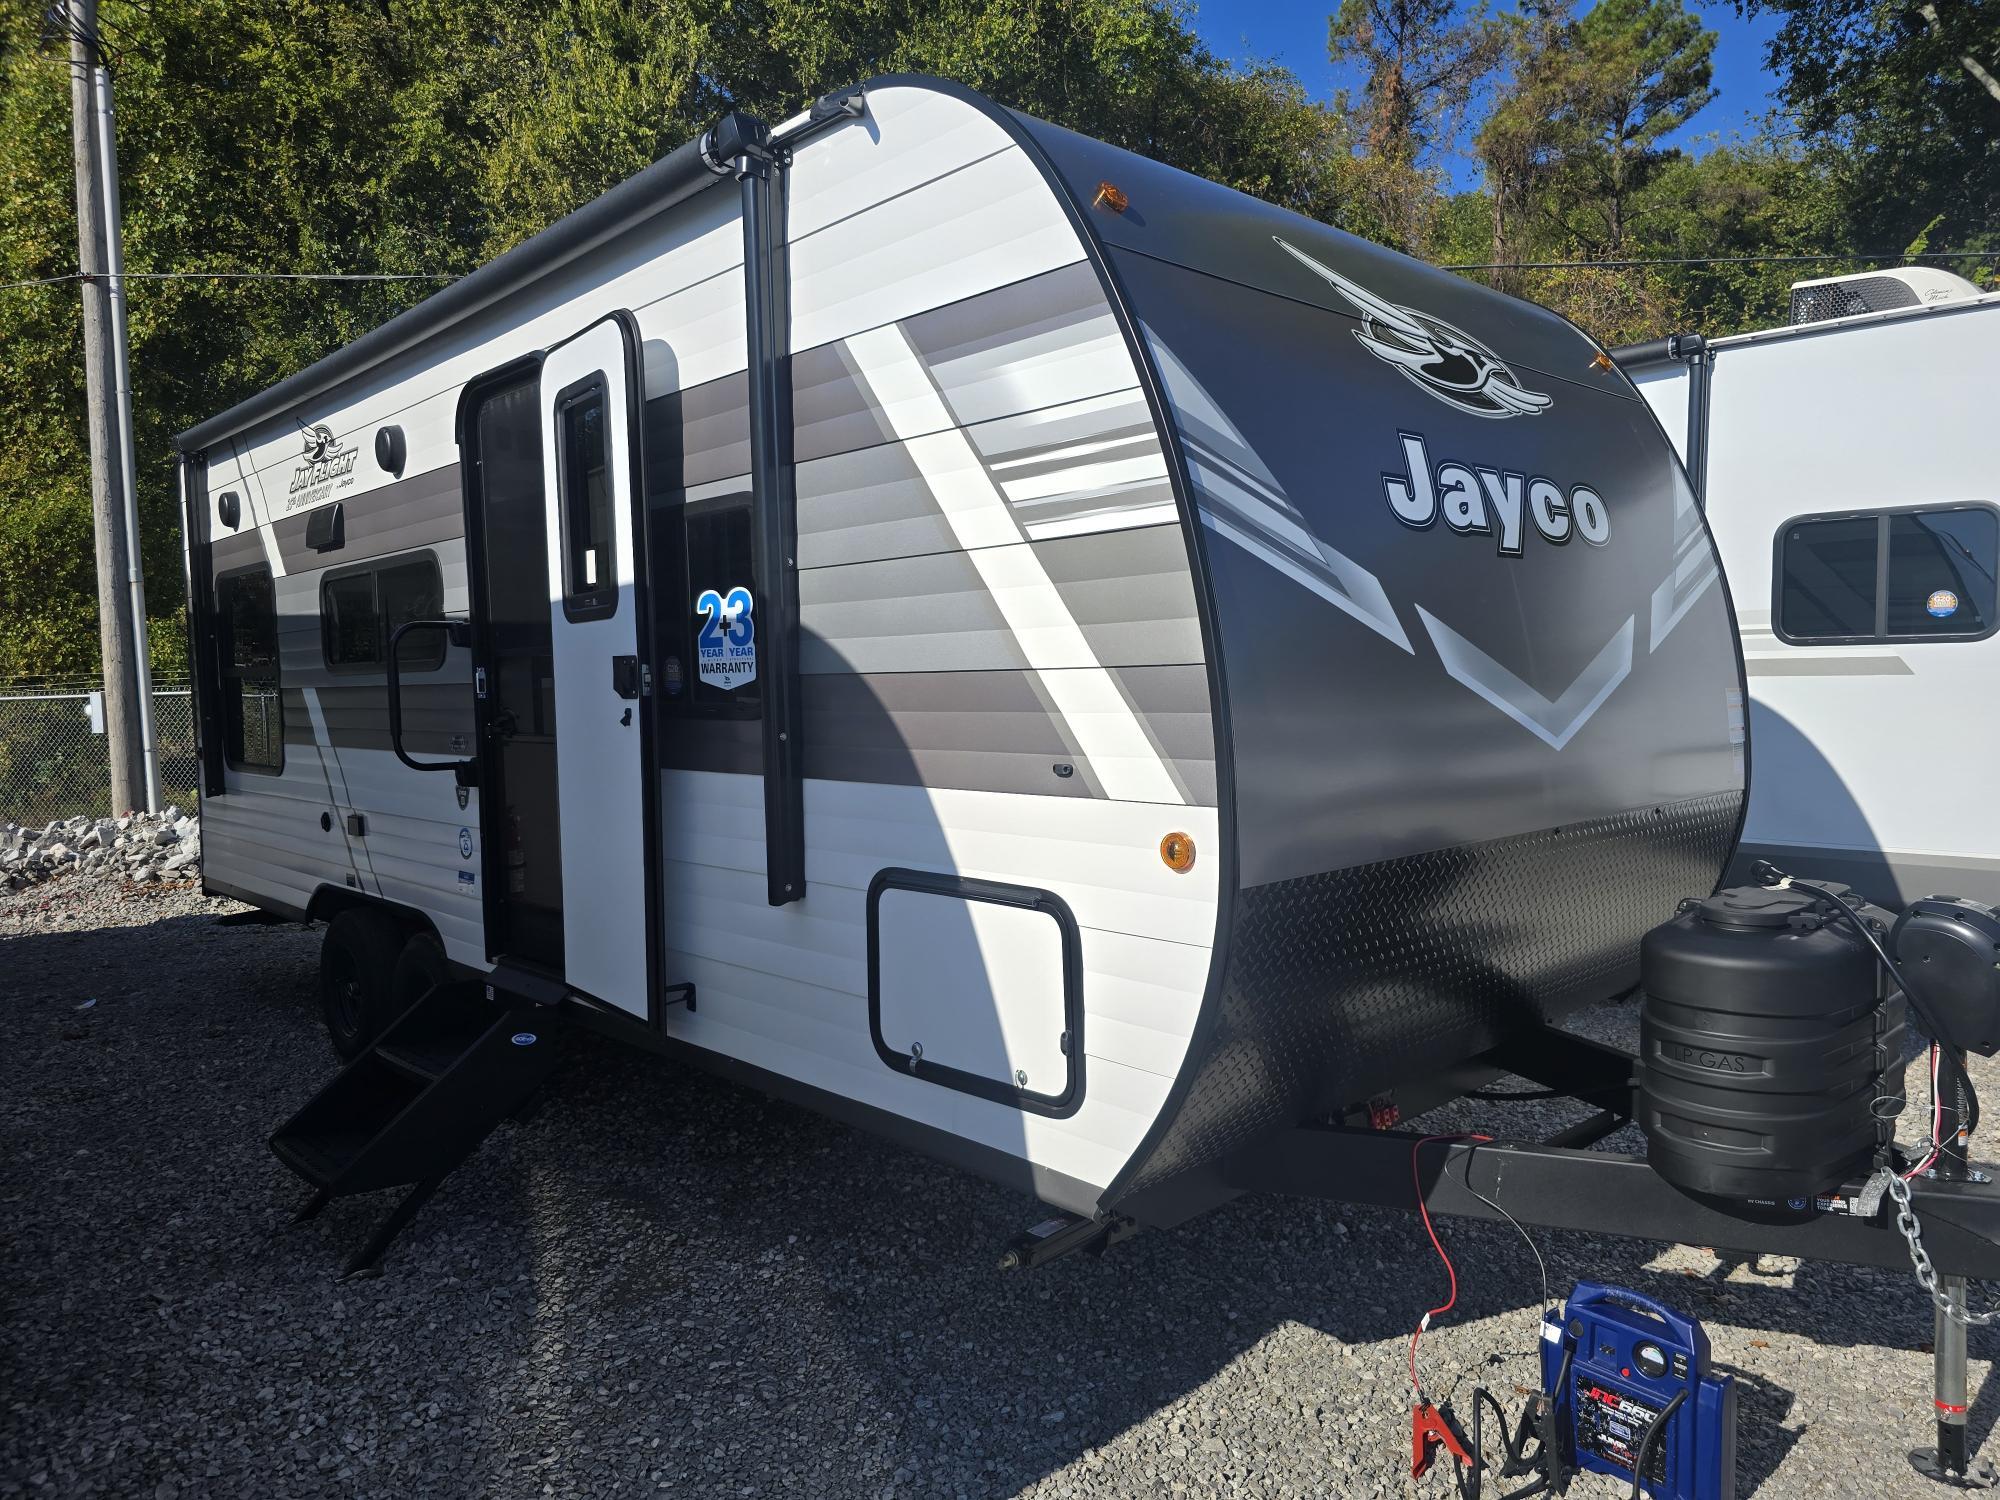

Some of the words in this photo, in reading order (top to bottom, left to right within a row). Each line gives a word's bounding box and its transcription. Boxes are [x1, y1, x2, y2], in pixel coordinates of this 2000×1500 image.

[1380, 429, 1612, 557] Jayco
[700, 648, 724, 658] YEAR
[728, 646, 754, 657] YEAR
[701, 661, 754, 674] WARRANTY
[1674, 1047, 1693, 1063] LP
[1699, 1051, 1745, 1072] GAS
